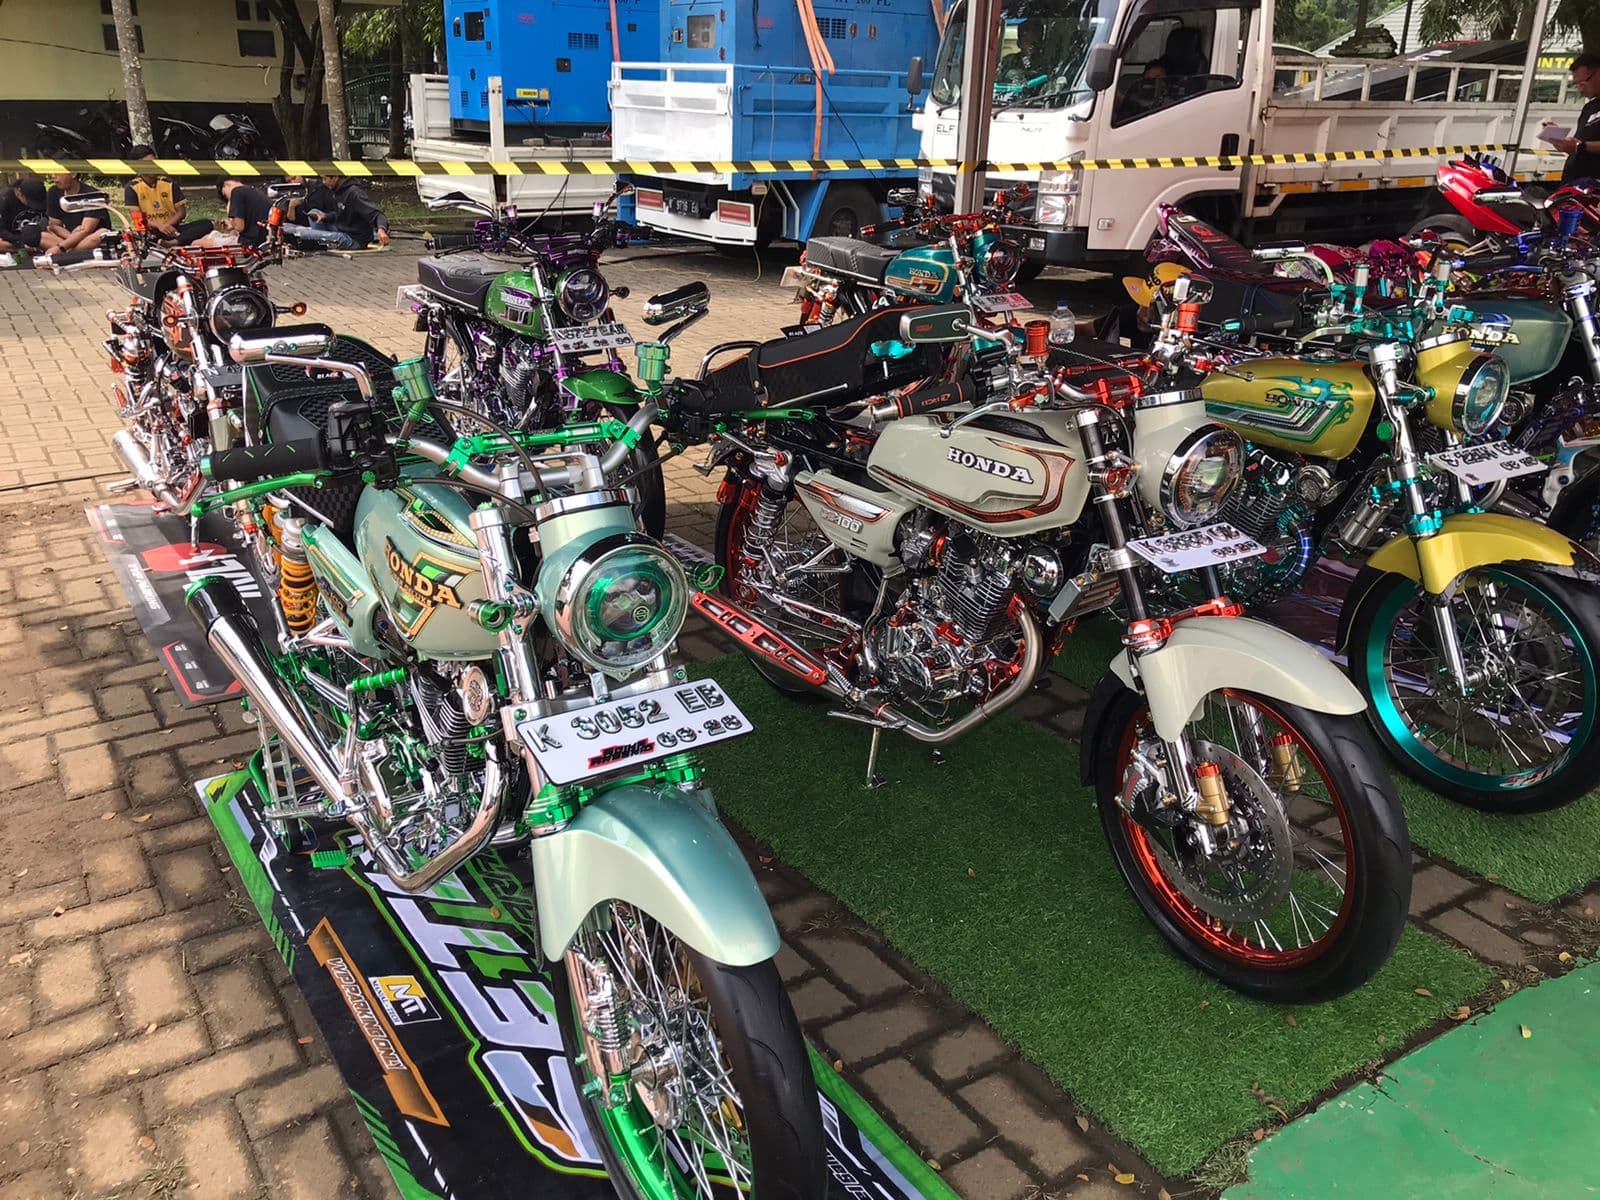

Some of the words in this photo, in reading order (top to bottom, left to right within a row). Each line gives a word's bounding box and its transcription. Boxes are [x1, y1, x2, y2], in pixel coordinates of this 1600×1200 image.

[936, 124, 955, 133] ELF
[908, 267, 938, 279] HONDA
[947, 447, 1033, 484] HONDA
[384, 537, 463, 609] HONDA
[528, 723, 562, 752] K
[571, 699, 669, 740] 3052
[674, 684, 725, 714] EB
[341, 983, 387, 1037] PARKING
[371, 1036, 408, 1071] ONLY
